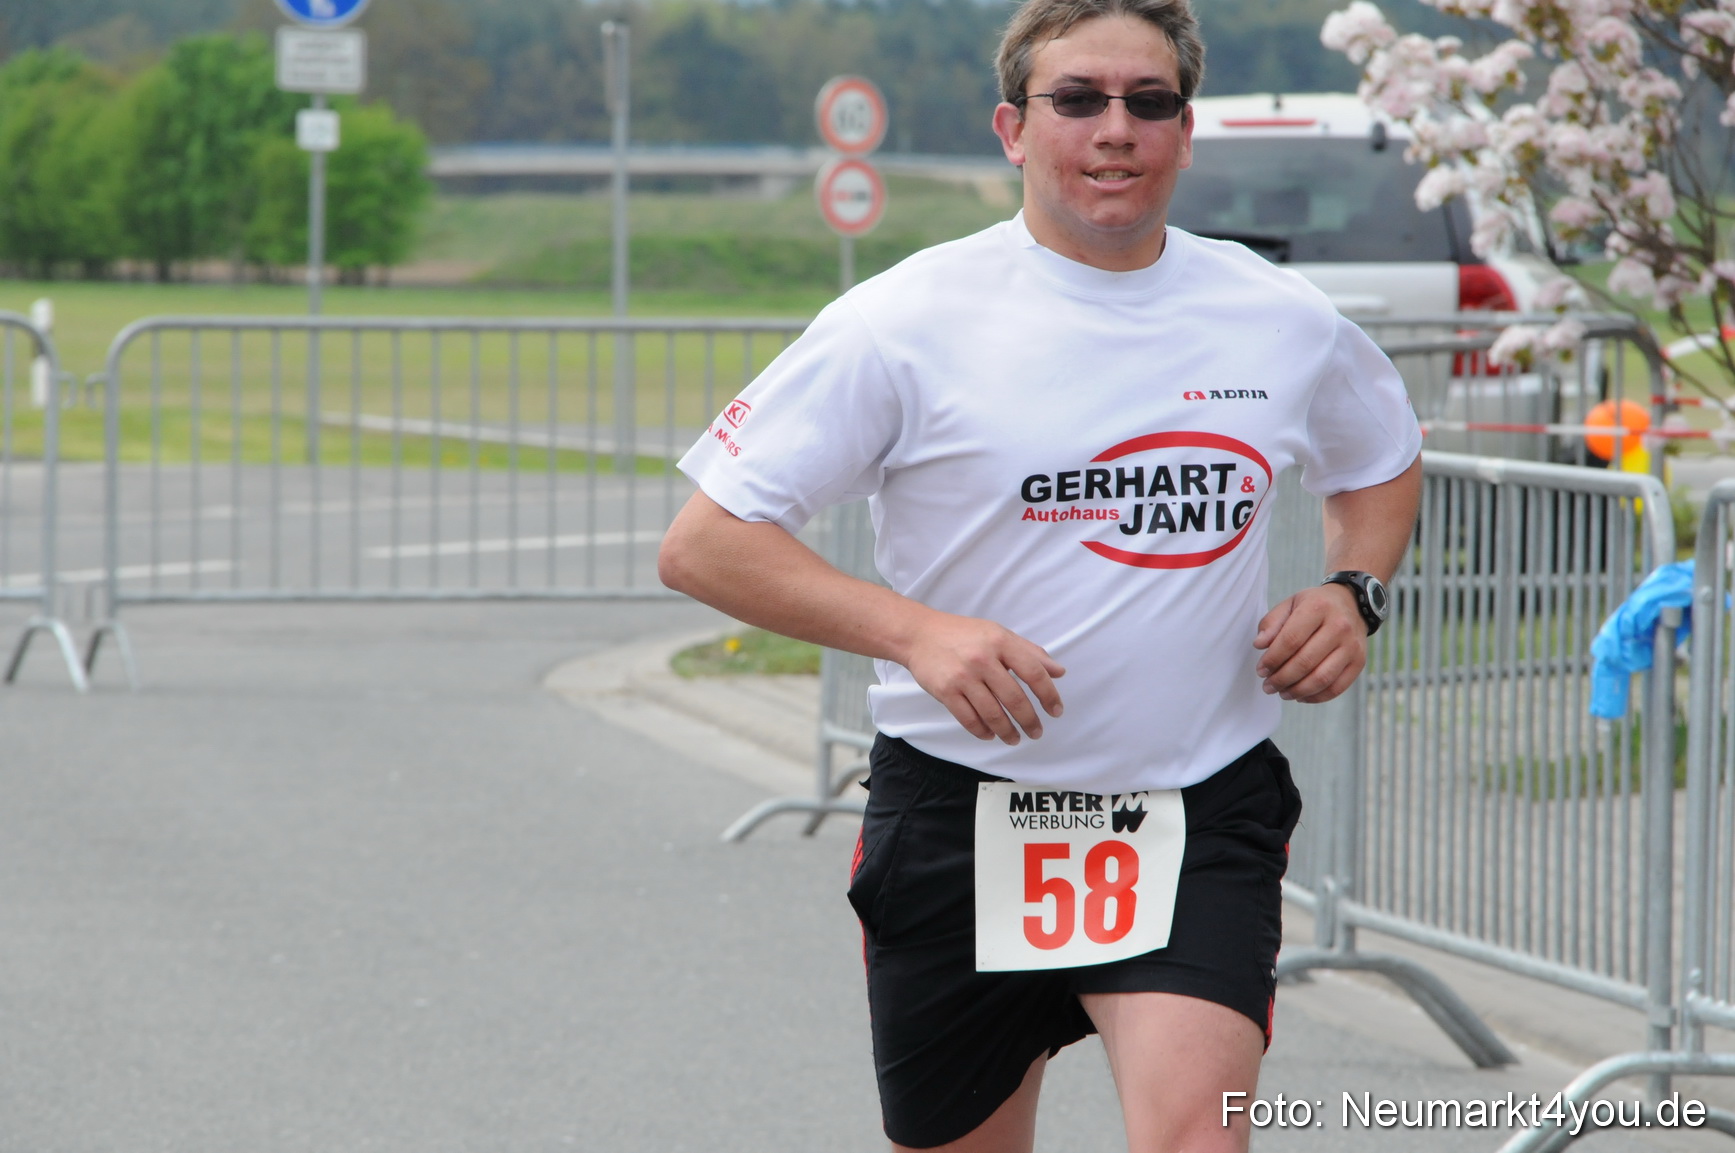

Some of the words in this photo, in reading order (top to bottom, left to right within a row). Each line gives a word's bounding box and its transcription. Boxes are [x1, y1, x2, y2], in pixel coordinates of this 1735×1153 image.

[1209, 389, 1268, 400] ADRIA
[1021, 463, 1236, 503] GERHART
[1240, 475, 1256, 493] &
[1021, 506, 1120, 523] Autohaus
[1119, 499, 1254, 536] JÄNIG
[1009, 791, 1104, 813] MEYER
[1009, 814, 1105, 830] WERBUNG
[1023, 839, 1140, 951] 58
